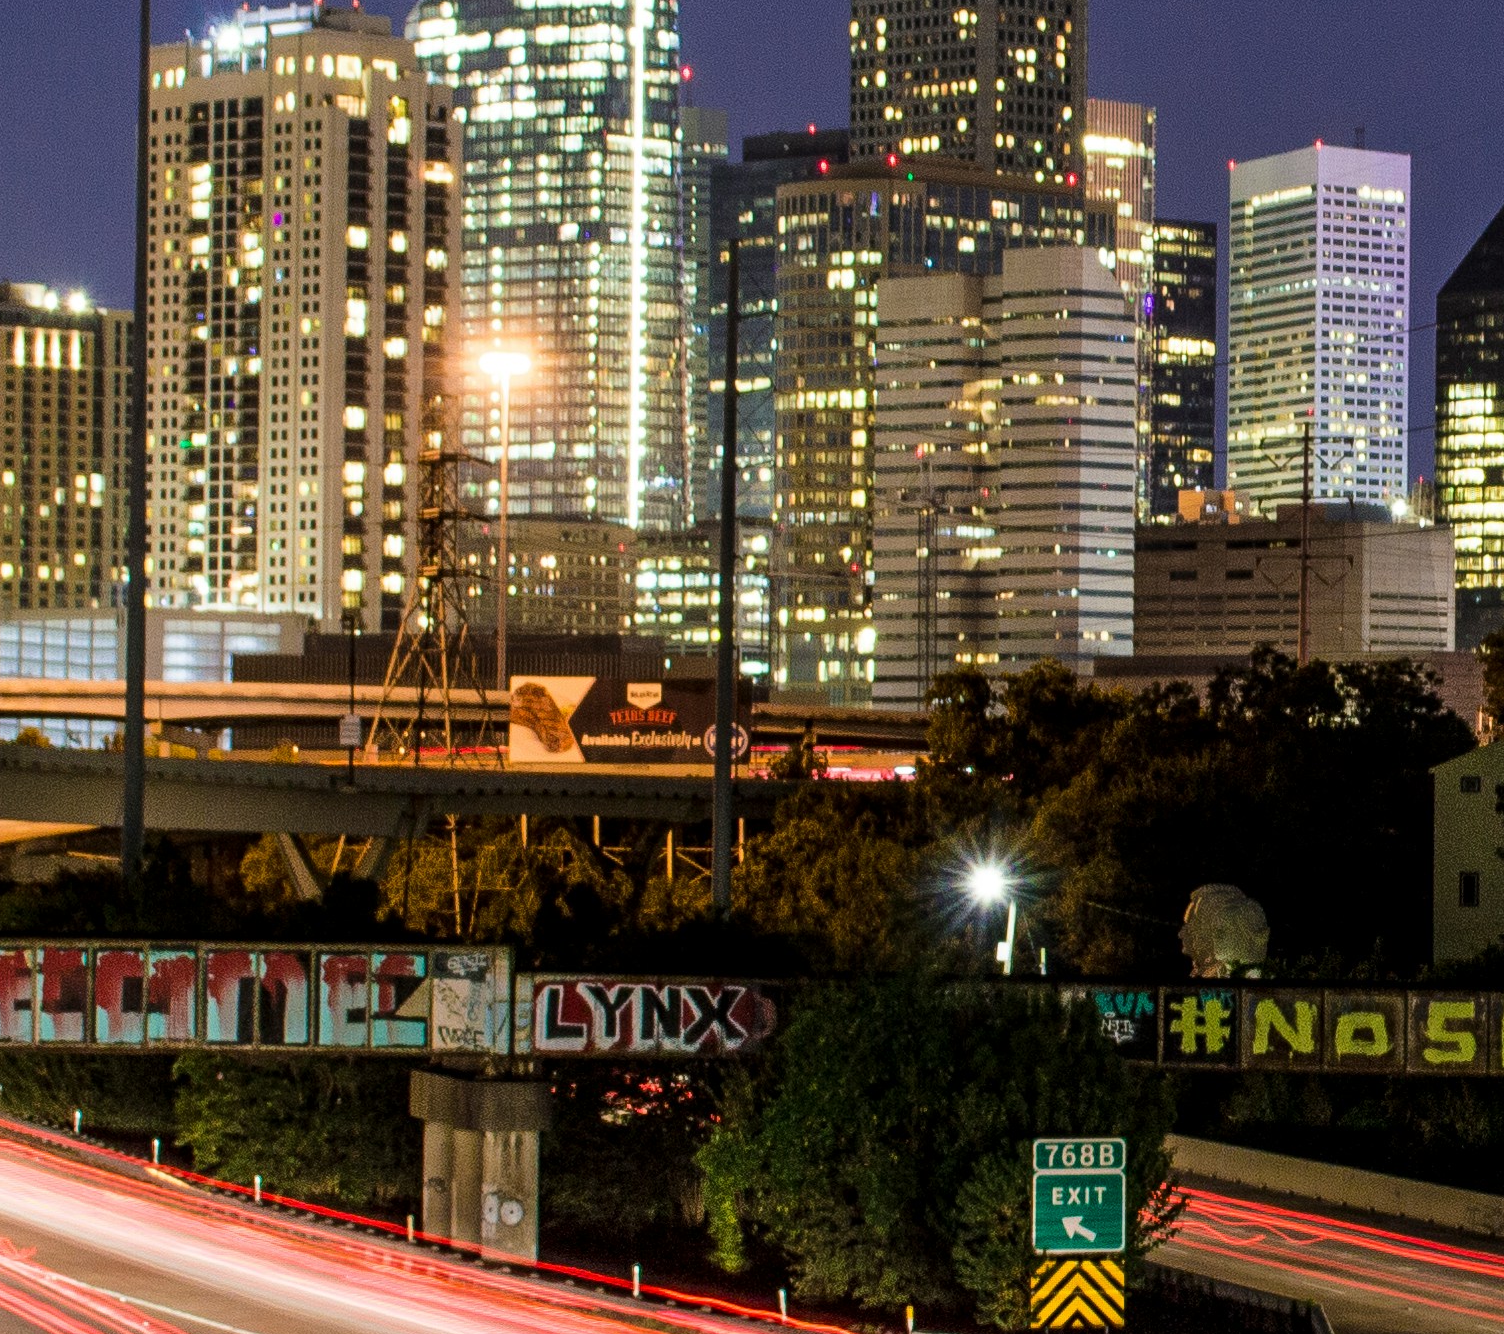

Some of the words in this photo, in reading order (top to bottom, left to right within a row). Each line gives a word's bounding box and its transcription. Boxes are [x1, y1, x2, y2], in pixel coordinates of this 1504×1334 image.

[580, 733, 630, 746] Available
[631, 730, 692, 750] Exclusively
[535, 983, 750, 1052] LYNX
[1045, 1144, 1114, 1167] 768B
[1052, 1186, 1107, 1206] EXIT
